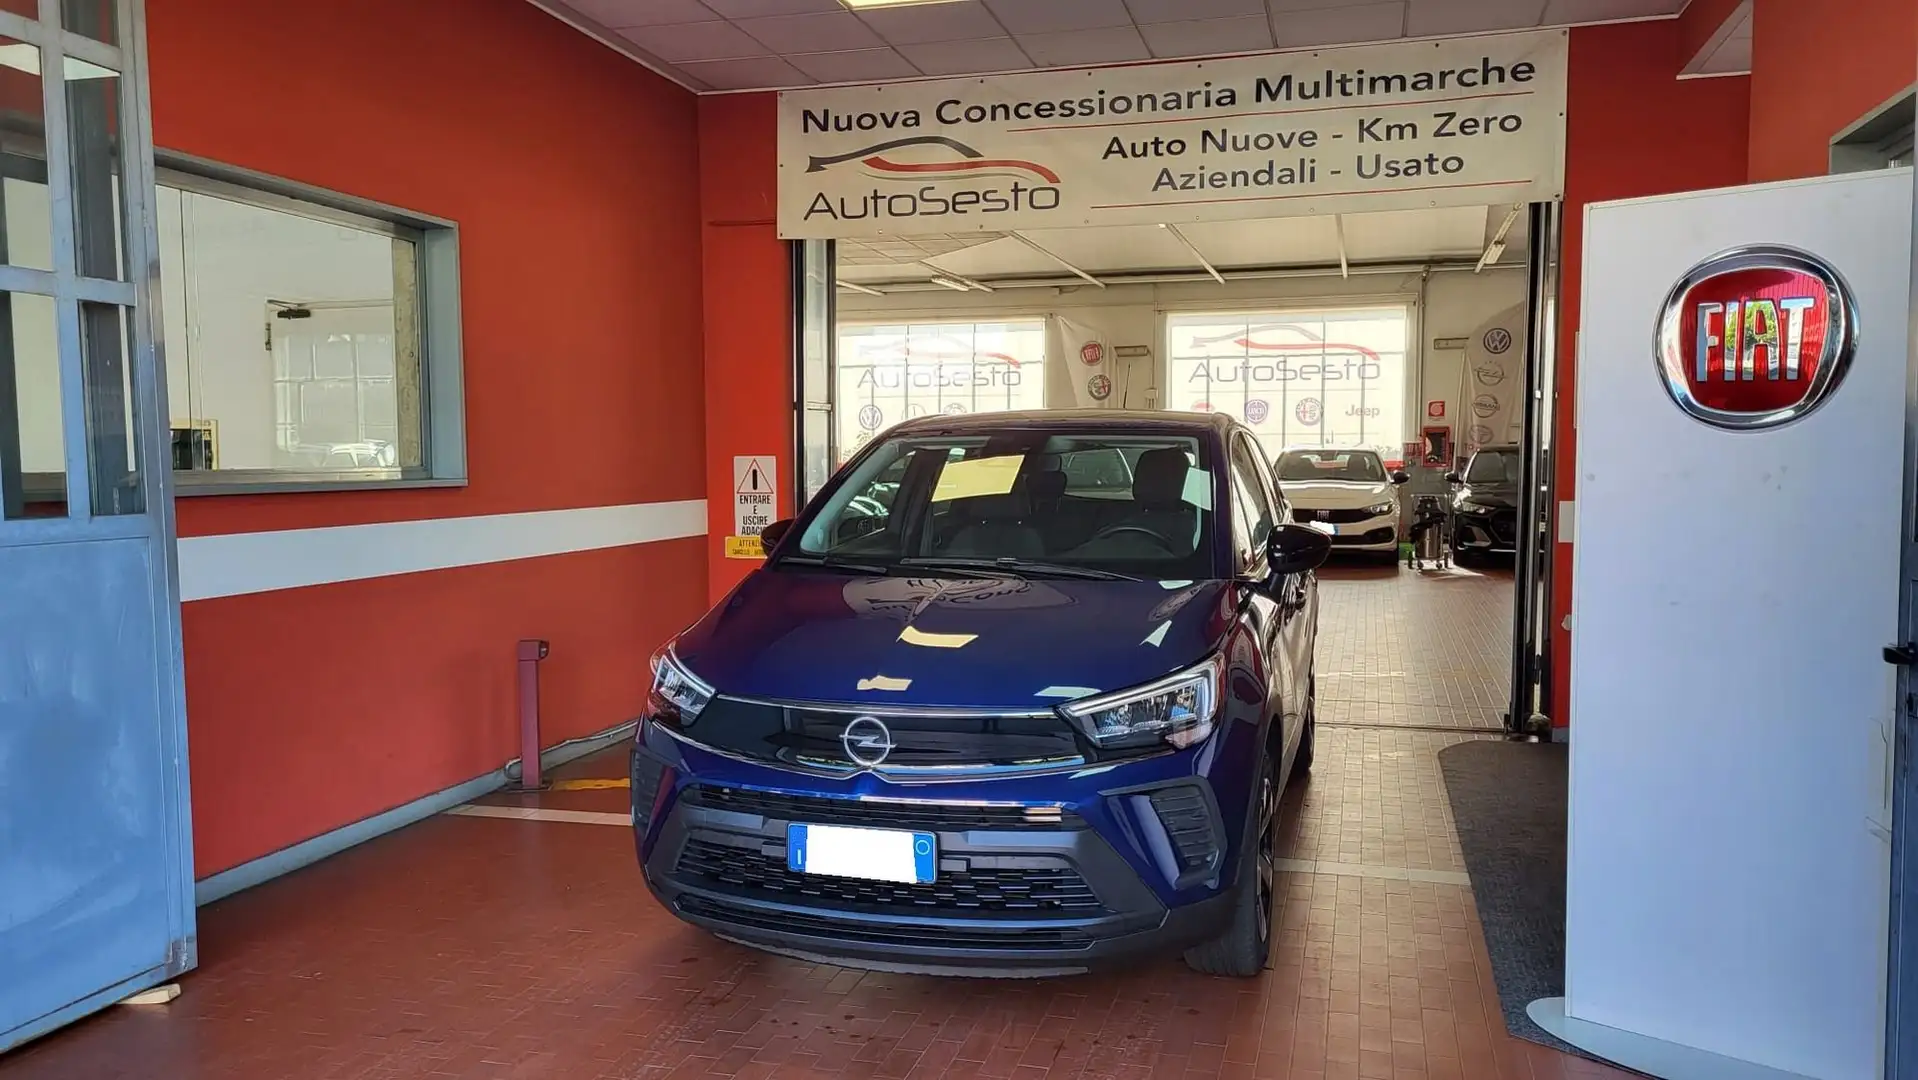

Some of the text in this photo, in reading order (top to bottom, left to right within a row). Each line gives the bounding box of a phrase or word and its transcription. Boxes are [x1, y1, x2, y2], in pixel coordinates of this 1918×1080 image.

[803, 57, 1536, 134] Nuova Concessionaria Multimarche
[1102, 135, 1187, 160] Auto
[1201, 128, 1318, 154] Nuove
[1358, 117, 1418, 144] Km
[1433, 111, 1522, 138] Zero
[1152, 158, 1317, 192] Aziendali
[1357, 152, 1465, 180] Usato
[803, 181, 1060, 221] AutoSesto
[1696, 296, 1815, 382] FIAT
[857, 365, 1022, 389] AutoSesto
[1189, 358, 1381, 383] AutoSesto
[1345, 404, 1380, 418] Jeep
[740, 494, 771, 505] ENTRARE
[753, 505, 758, 515] E
[742, 515, 768, 526] USCIRE
